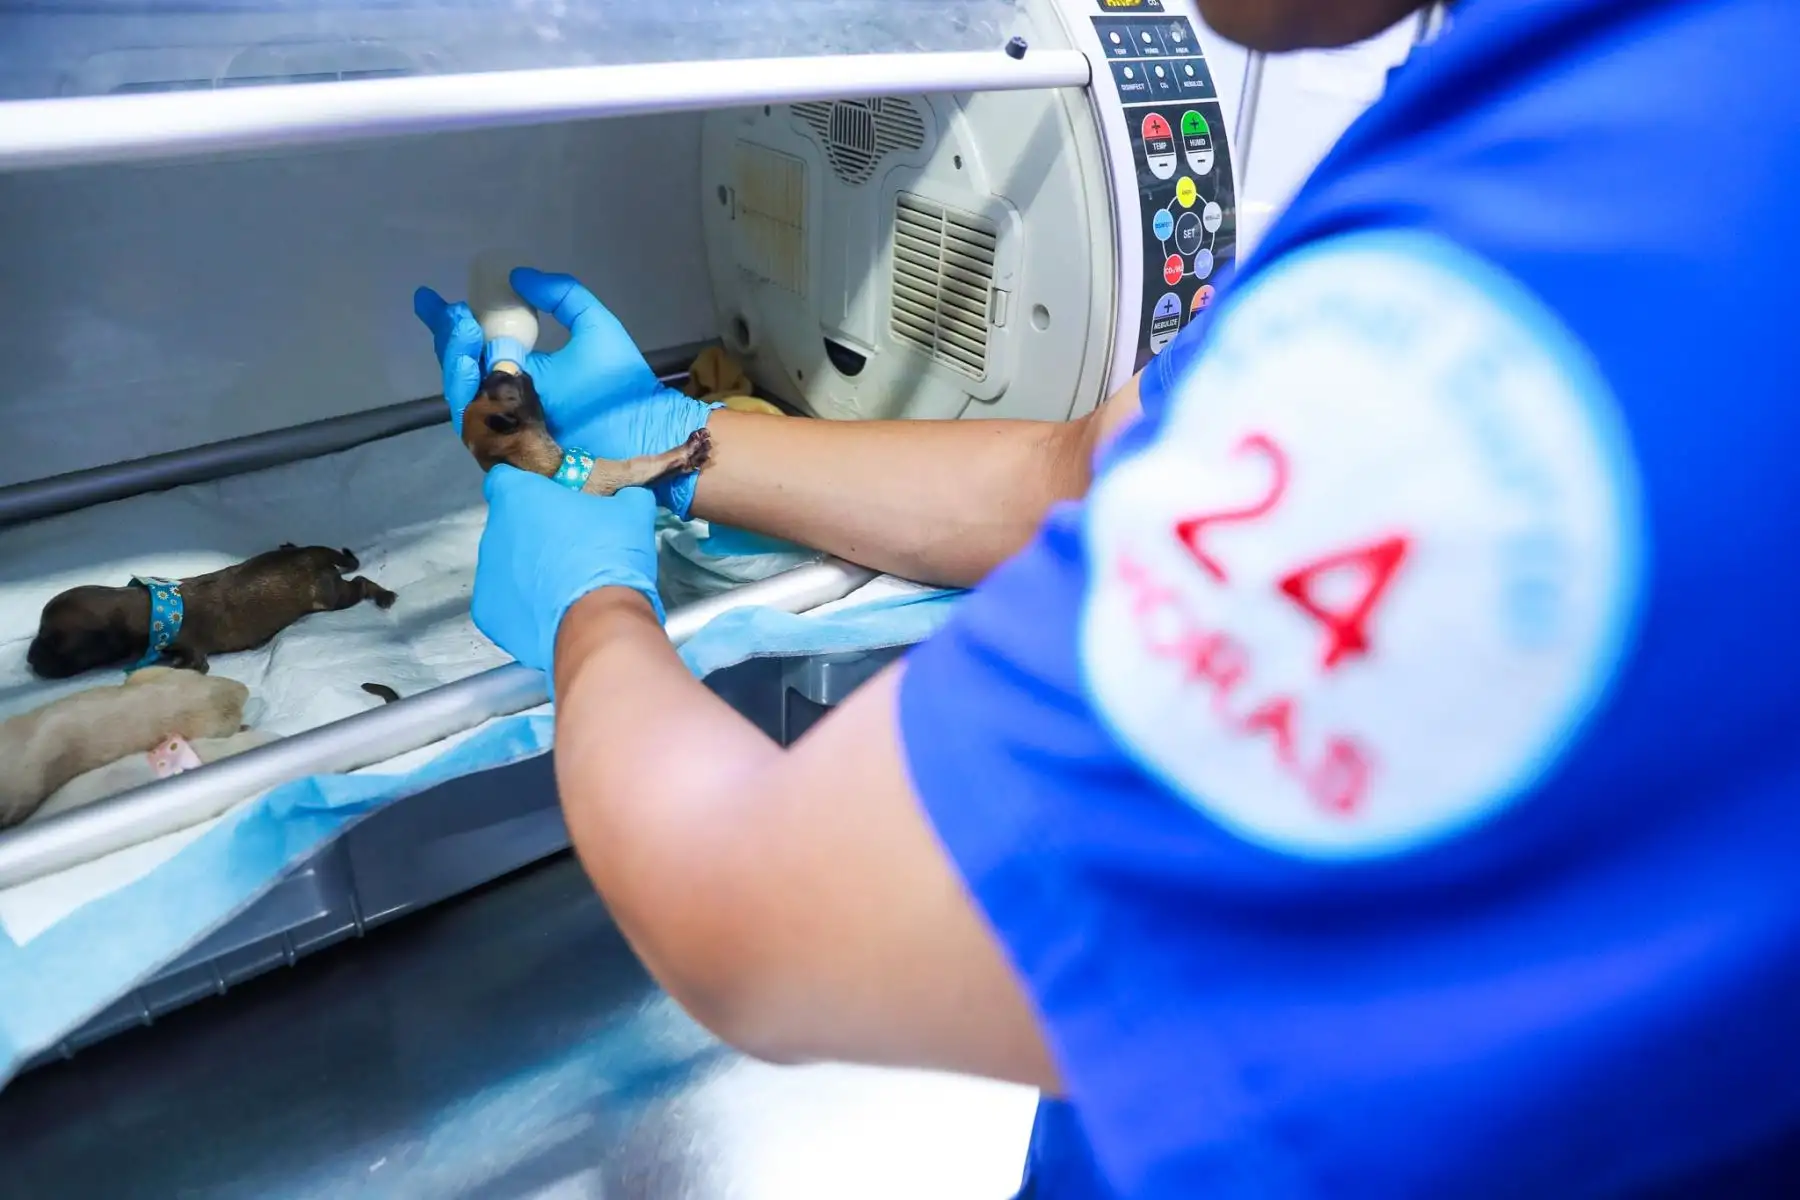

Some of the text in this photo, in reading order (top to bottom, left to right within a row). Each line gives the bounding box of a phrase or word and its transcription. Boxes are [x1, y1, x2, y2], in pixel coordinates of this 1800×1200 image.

[1152, 142, 1167, 151] TEMP
[1189, 138, 1206, 147] HUMID
[1183, 227, 1196, 239] SET
[1154, 318, 1178, 330] NEBULIZE
[1174, 431, 1415, 671] 24
